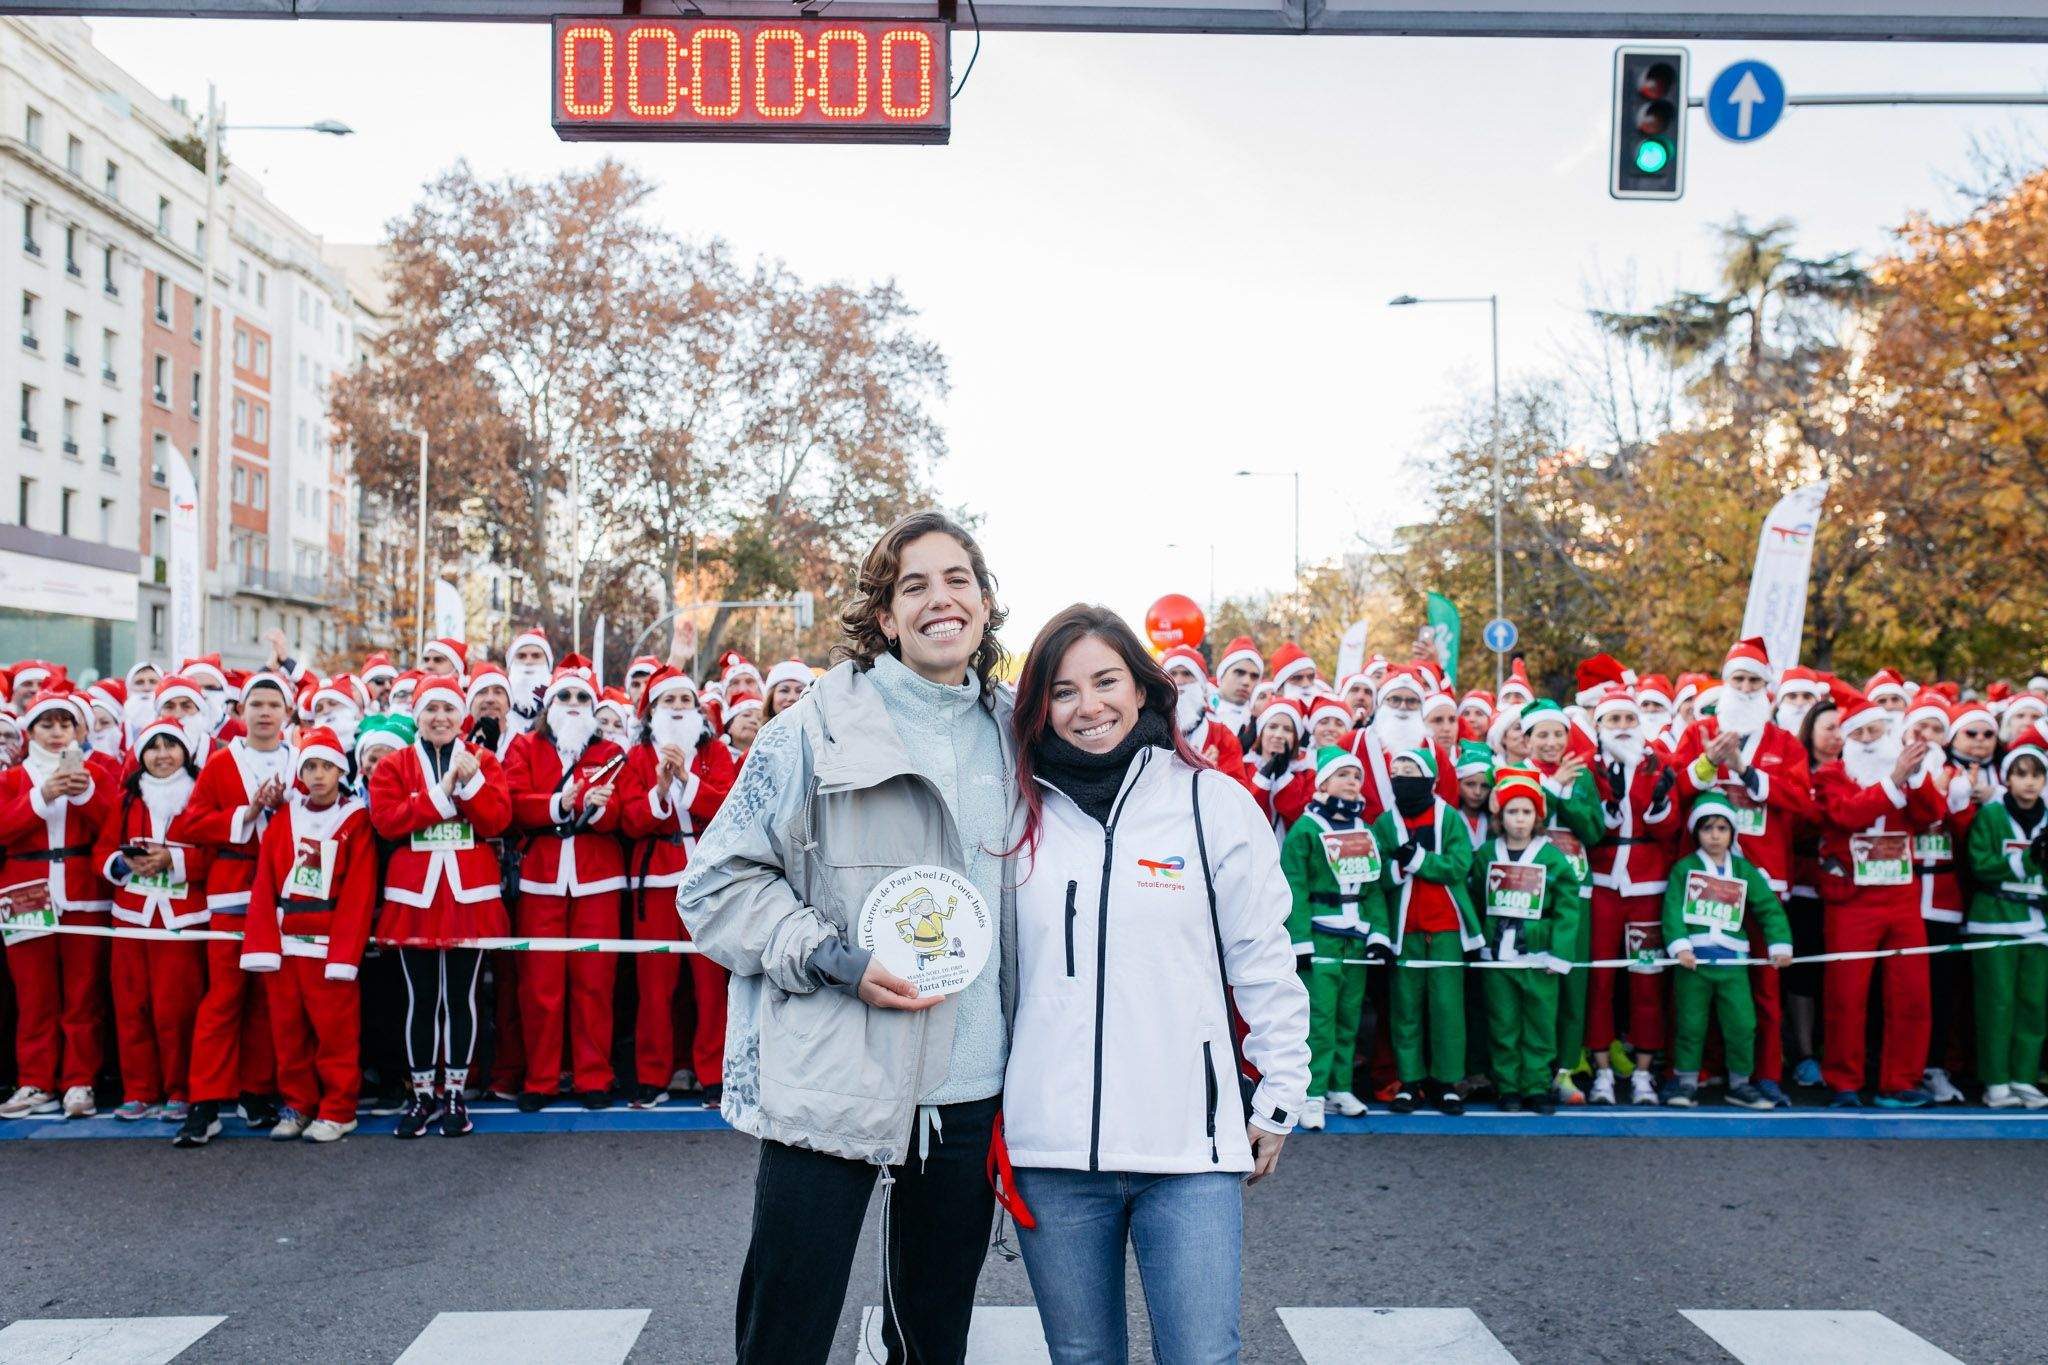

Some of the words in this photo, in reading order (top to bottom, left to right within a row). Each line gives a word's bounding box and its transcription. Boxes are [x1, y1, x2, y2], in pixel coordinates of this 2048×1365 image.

[564, 27, 931, 117] 00:00:00
[423, 822, 462, 840] 4456
[1136, 880, 1185, 891] TotalEnergies
[864, 898, 882, 933] Carrera
[880, 887, 891, 898] de
[889, 873, 913, 889] Papá
[914, 870, 937, 880] Noel
[939, 873, 951, 883] El
[951, 879, 974, 901] Corte
[972, 899, 987, 929] Inglés
[941, 977, 964, 988] Pérez
